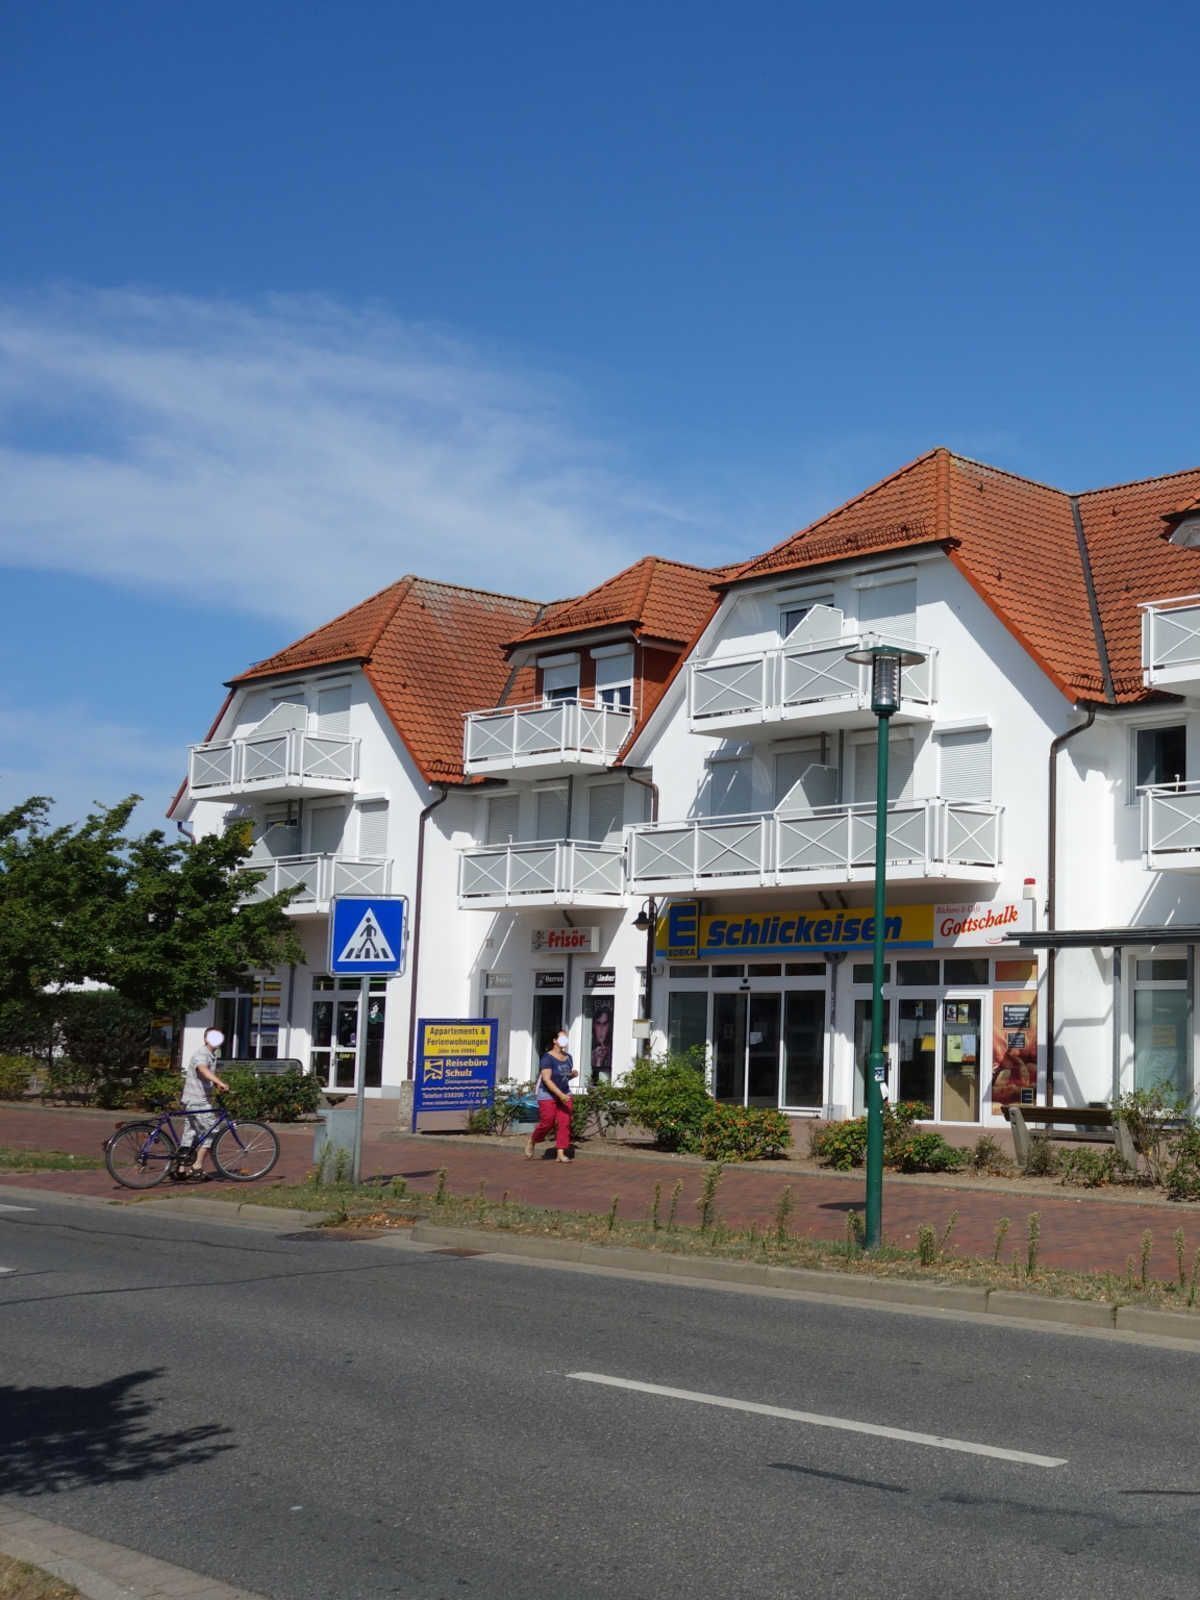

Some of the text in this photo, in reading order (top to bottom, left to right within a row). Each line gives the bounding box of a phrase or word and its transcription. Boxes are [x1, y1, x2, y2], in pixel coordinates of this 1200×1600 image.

[941, 904, 1019, 937] Gottschalk
[706, 912, 903, 947] Schlickeisen
[548, 930, 587, 949] Frisör
[426, 1037, 489, 1047] Ferienwohnungen
[446, 1058, 489, 1067] Reisebüro
[446, 1068, 472, 1077] Schulz
